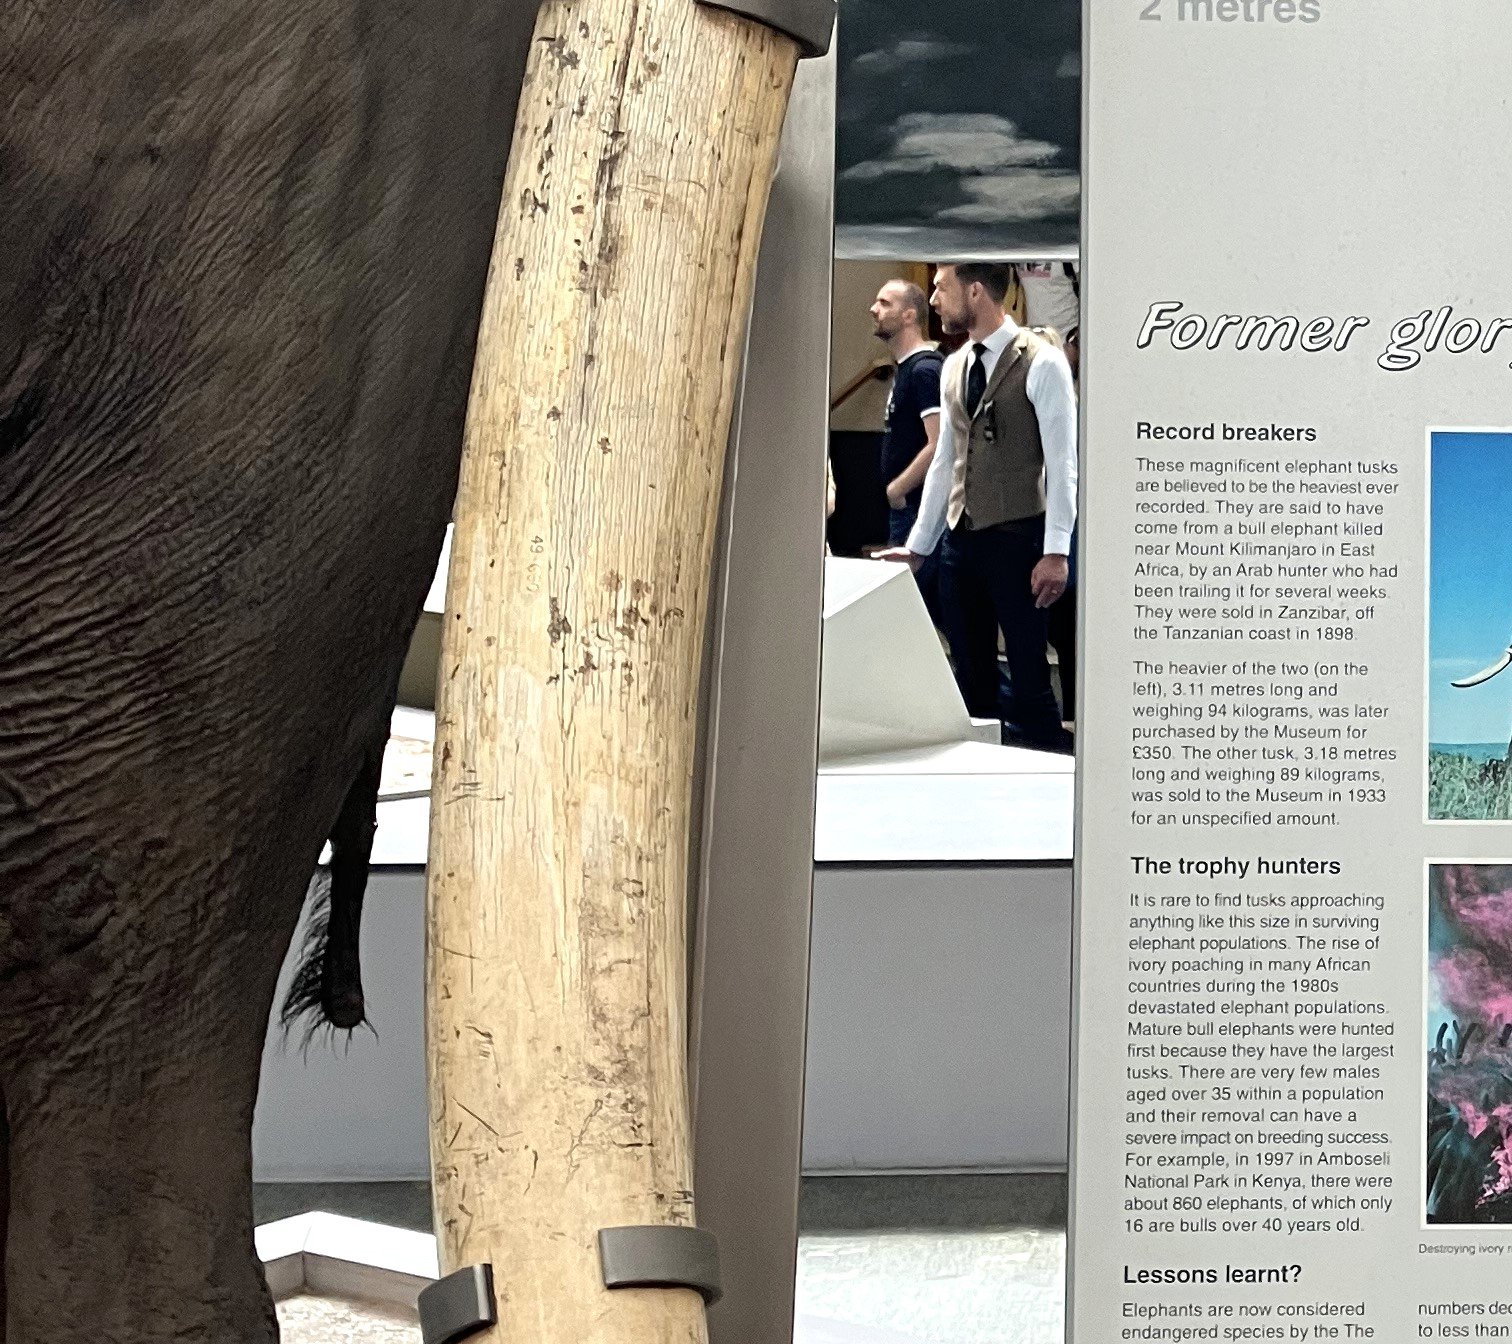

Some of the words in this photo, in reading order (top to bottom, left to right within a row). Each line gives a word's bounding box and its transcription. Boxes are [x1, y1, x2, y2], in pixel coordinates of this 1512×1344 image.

[1136, 300, 1370, 352] Former
[1137, 422, 1214, 440] Record
[1223, 423, 1316, 441] breakers
[1135, 457, 1184, 472] These
[1190, 458, 1280, 476] magnificent
[1285, 459, 1352, 476] elephant
[1358, 460, 1398, 474] tusks
[1136, 481, 1159, 492] are
[1164, 479, 1227, 492] believed
[1230, 479, 1245, 493] to
[1249, 479, 1267, 493] be
[1272, 480, 1295, 494] the
[1300, 480, 1362, 494] heaviest
[1366, 483, 1399, 494] ever
[1214, 500, 1254, 517] They
[1259, 503, 1285, 514] are
[1289, 501, 1321, 514] said
[1327, 502, 1341, 514] to
[1347, 501, 1383, 515] have
[1135, 524, 1178, 534] come
[1183, 520, 1218, 534] from
[1224, 524, 1233, 535] a
[1239, 521, 1265, 535] bull
[1271, 521, 1338, 538] elephant
[1344, 521, 1383, 536] killed
[1135, 545, 1170, 555] near
[1176, 542, 1224, 555] Mount
[1230, 541, 1316, 560] Kilimanjaro
[1322, 543, 1335, 557] in
[1341, 543, 1375, 557] East
[1132, 724, 1215, 741] purchased
[1221, 725, 1239, 743] by
[1245, 725, 1268, 738] the
[1274, 725, 1341, 739] Museum
[1347, 725, 1367, 739] for
[1181, 746, 1211, 759] The
[1217, 746, 1257, 759] other
[1262, 746, 1298, 762] tusk,
[1304, 747, 1338, 760] 3.18
[1344, 746, 1396, 760] metres
[1132, 767, 1165, 784] long
[1171, 767, 1200, 781] and
[1205, 767, 1275, 784] weighing
[1281, 768, 1299, 781] 89
[1305, 767, 1384, 785] kilograms,
[1131, 791, 1163, 802] was
[1169, 788, 1200, 802] sold
[1206, 788, 1220, 802] to
[1226, 788, 1250, 802] the
[1256, 788, 1322, 802] Museum
[1329, 788, 1341, 802] in
[1349, 788, 1386, 802] 1933
[1131, 810, 1152, 825] for
[1157, 814, 1176, 825] an
[1182, 811, 1271, 828] unspecified
[1277, 812, 1339, 825] amount.
[1130, 857, 1171, 874] The
[1178, 857, 1250, 879] trophy
[1258, 857, 1340, 874] hunters
[1130, 893, 1139, 907] It
[1144, 893, 1156, 907] is
[1161, 896, 1191, 907] rare
[1196, 894, 1209, 907] to
[1215, 893, 1241, 907] find
[1247, 893, 1286, 907] tusks
[1291, 893, 1384, 910] approaching
[1130, 914, 1194, 932] anything
[1199, 914, 1224, 928] like
[1229, 914, 1255, 928] this
[1260, 913, 1290, 928] size
[1295, 914, 1307, 928] in
[1313, 914, 1380, 932] surviving
[1129, 936, 1195, 953] elephant
[1200, 936, 1291, 954] populations.
[1295, 936, 1326, 949] The
[1332, 936, 1359, 950] rise
[1365, 936, 1379, 949] of
[1125, 1174, 1188, 1188] National
[1194, 1174, 1229, 1188] Park
[1234, 1174, 1248, 1188] in
[1253, 1174, 1305, 1191] Kenya,
[1311, 1174, 1350, 1187] there
[1355, 1176, 1392, 1187] were
[1124, 1195, 1168, 1210] about
[1173, 1197, 1202, 1210] 860
[1207, 1195, 1287, 1213] elephants,
[1292, 1195, 1307, 1209] of
[1311, 1195, 1355, 1210] which
[1361, 1195, 1392, 1213] only
[1125, 1219, 1143, 1233] 16
[1149, 1221, 1174, 1232] are
[1180, 1217, 1217, 1232] bulls
[1222, 1221, 1257, 1232] over
[1262, 1218, 1282, 1231] 40
[1287, 1221, 1331, 1235] years
[1419, 1244, 1475, 1256] Destroying
[1479, 1242, 1504, 1256] ivory
[1124, 1265, 1218, 1283] Lessons
[1226, 1264, 1301, 1283] learnt?
[1123, 1303, 1202, 1320] Elephants
[1208, 1306, 1233, 1317] are
[1239, 1305, 1272, 1316] now
[1277, 1302, 1364, 1316] considered
[1419, 1301, 1485, 1315] numbers
[1122, 1324, 1218, 1343] endangered
[1223, 1324, 1284, 1342] species
[1290, 1324, 1309, 1342] by
[1314, 1324, 1338, 1338] the
[1343, 1324, 1374, 1338] The
[1419, 1324, 1433, 1337] to
[1438, 1323, 1469, 1337] less
[1475, 1323, 1509, 1337] than
